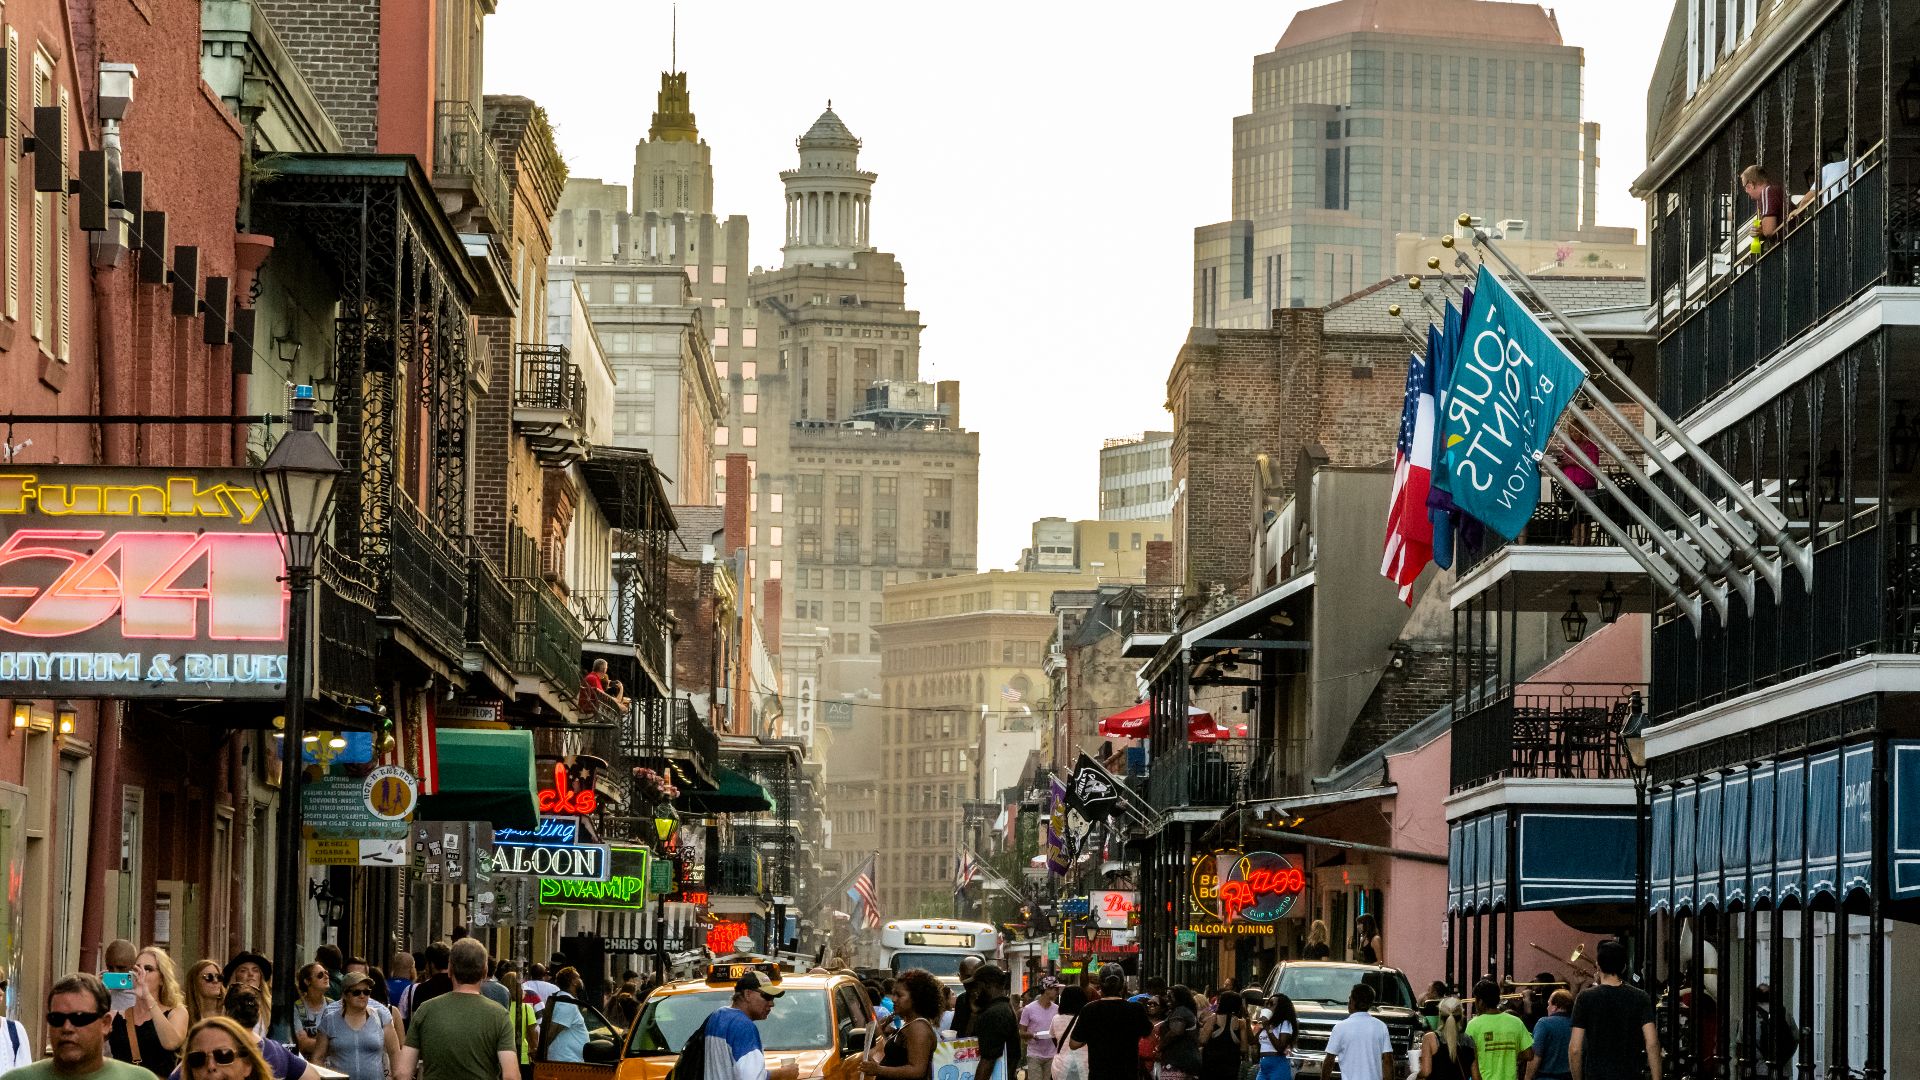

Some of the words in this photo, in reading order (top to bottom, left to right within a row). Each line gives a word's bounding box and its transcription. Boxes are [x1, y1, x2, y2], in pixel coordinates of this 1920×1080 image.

[0, 529, 291, 640] 544
[143, 653, 178, 682] &
[542, 876, 641, 901] SWAMP
[1238, 925, 1274, 934] DINING
[605, 938, 640, 950] CHRIS
